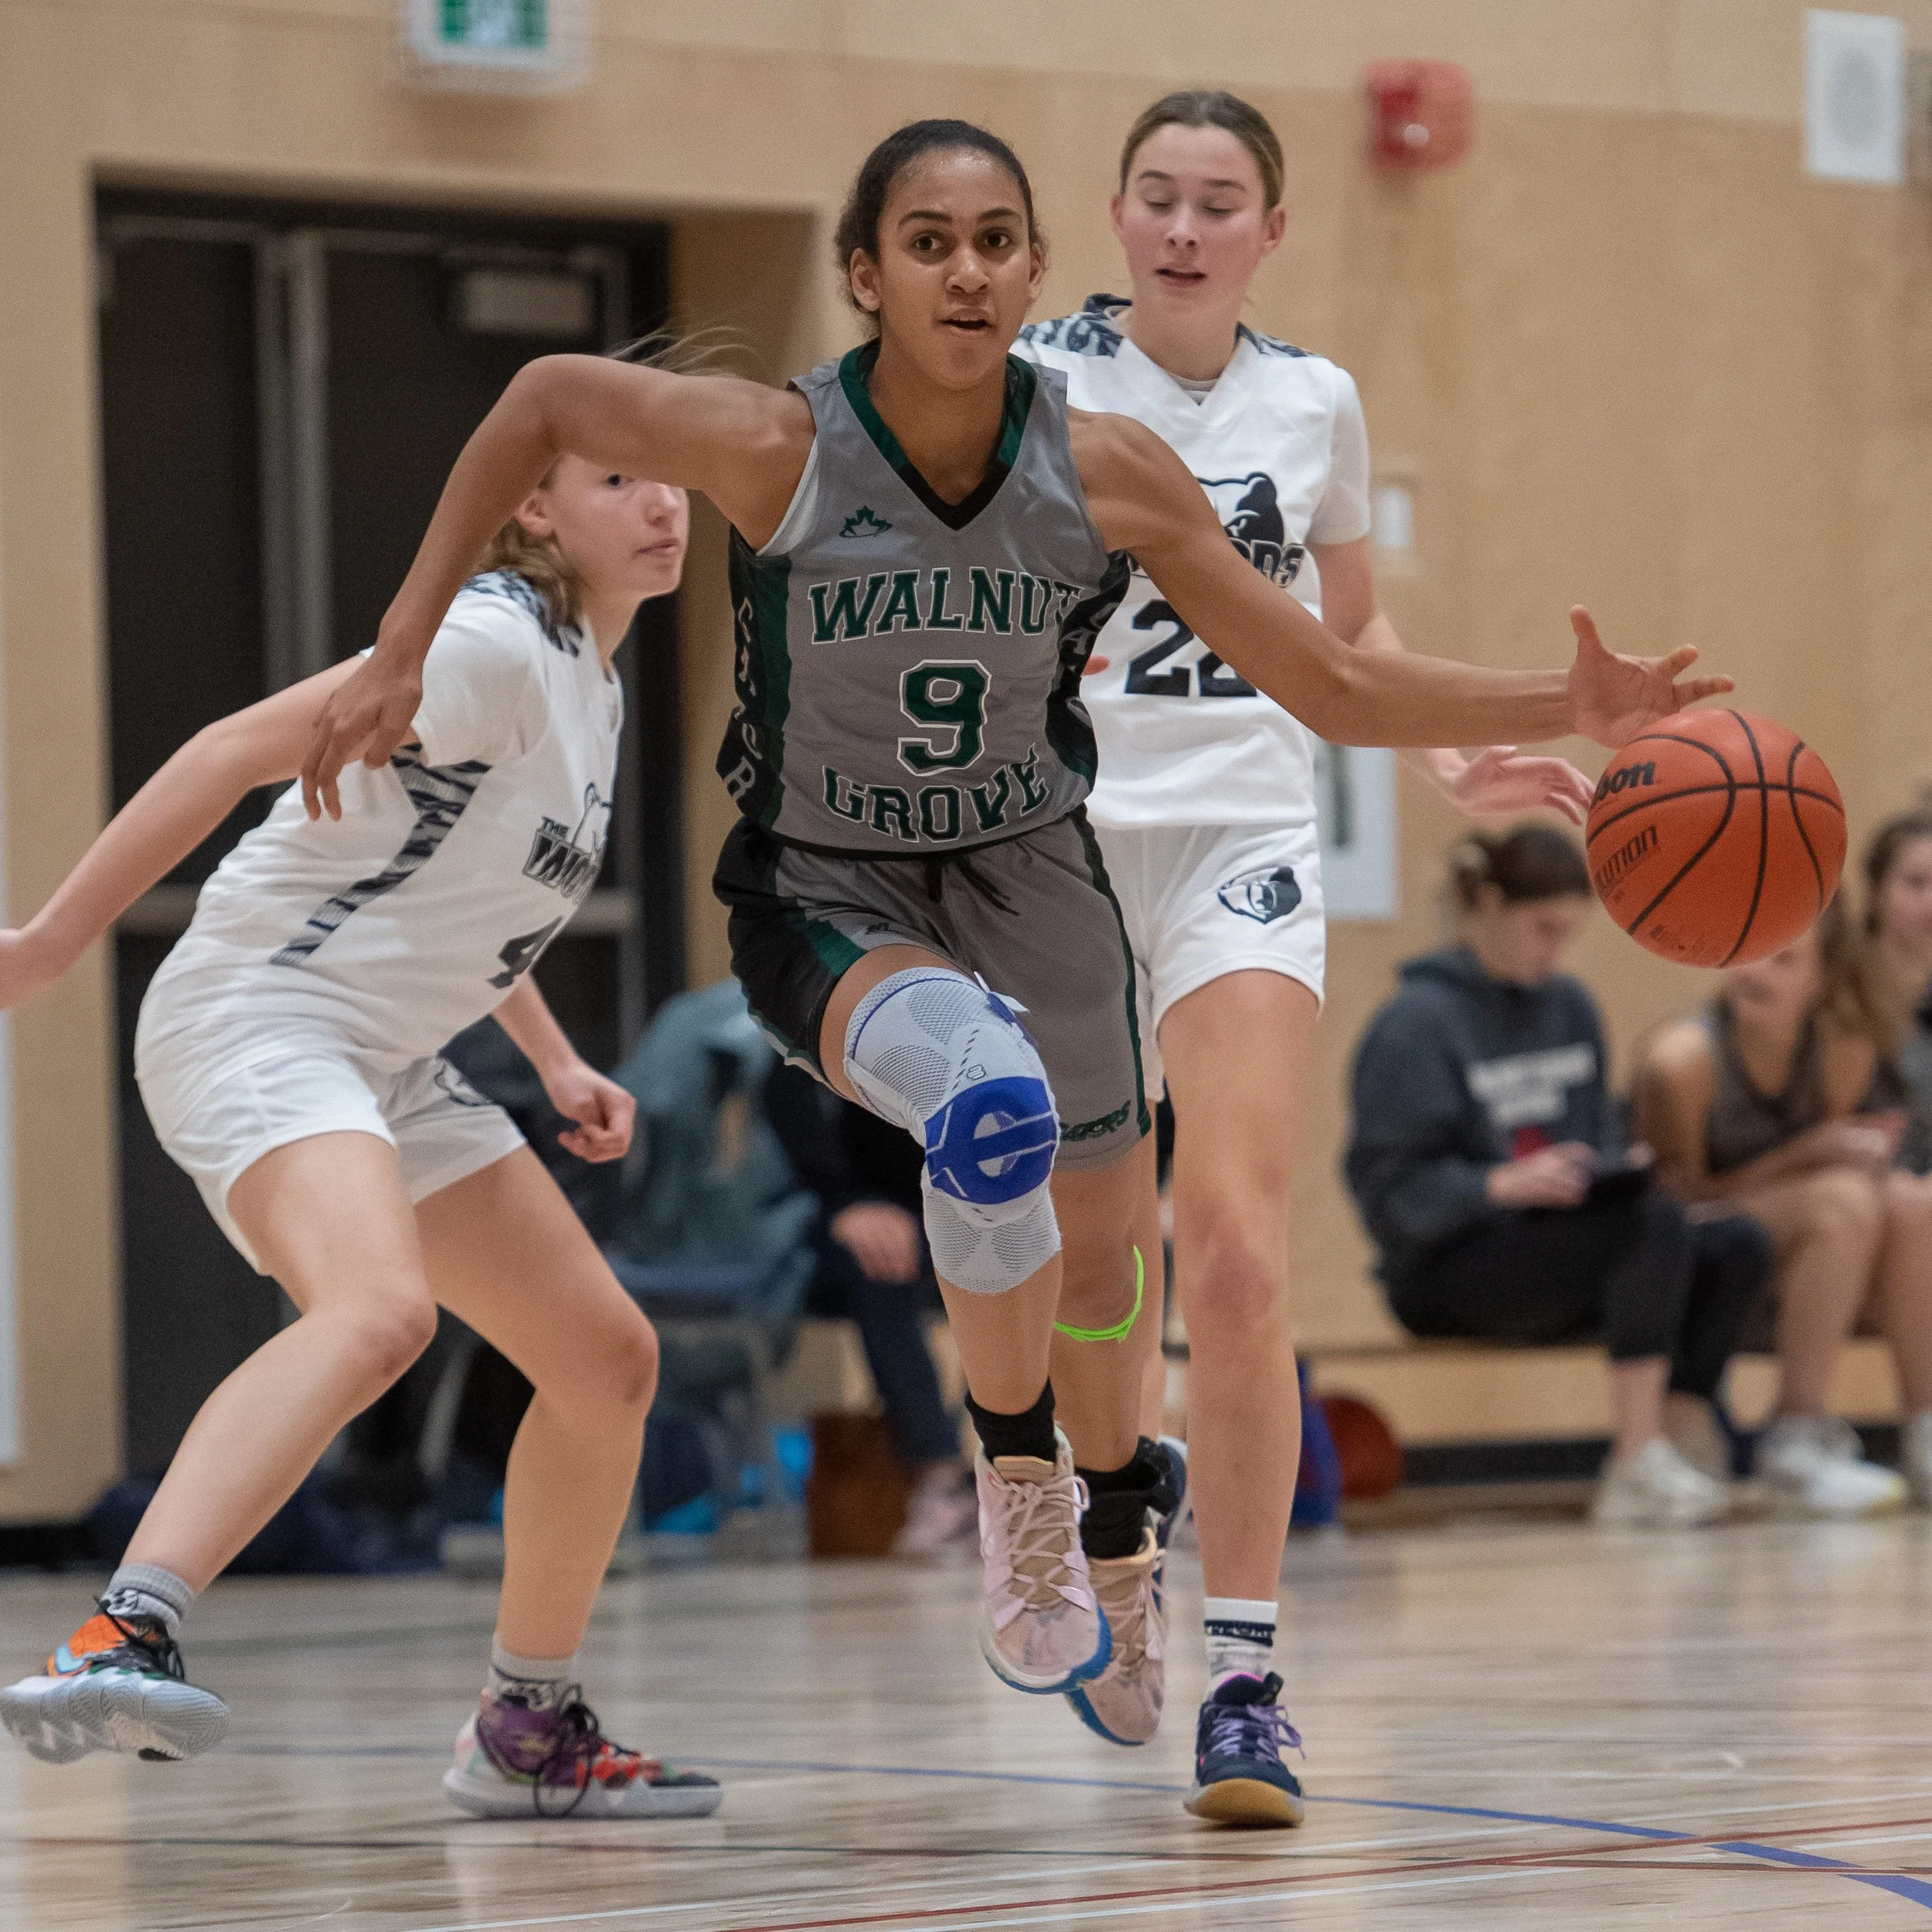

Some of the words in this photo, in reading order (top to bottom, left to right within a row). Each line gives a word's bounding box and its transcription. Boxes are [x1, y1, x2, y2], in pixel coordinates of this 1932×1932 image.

[808, 566, 1085, 644] WALNUT
[896, 658, 992, 777] 9
[821, 743, 1049, 843] GROVE
[1594, 825, 1658, 889] UTION
